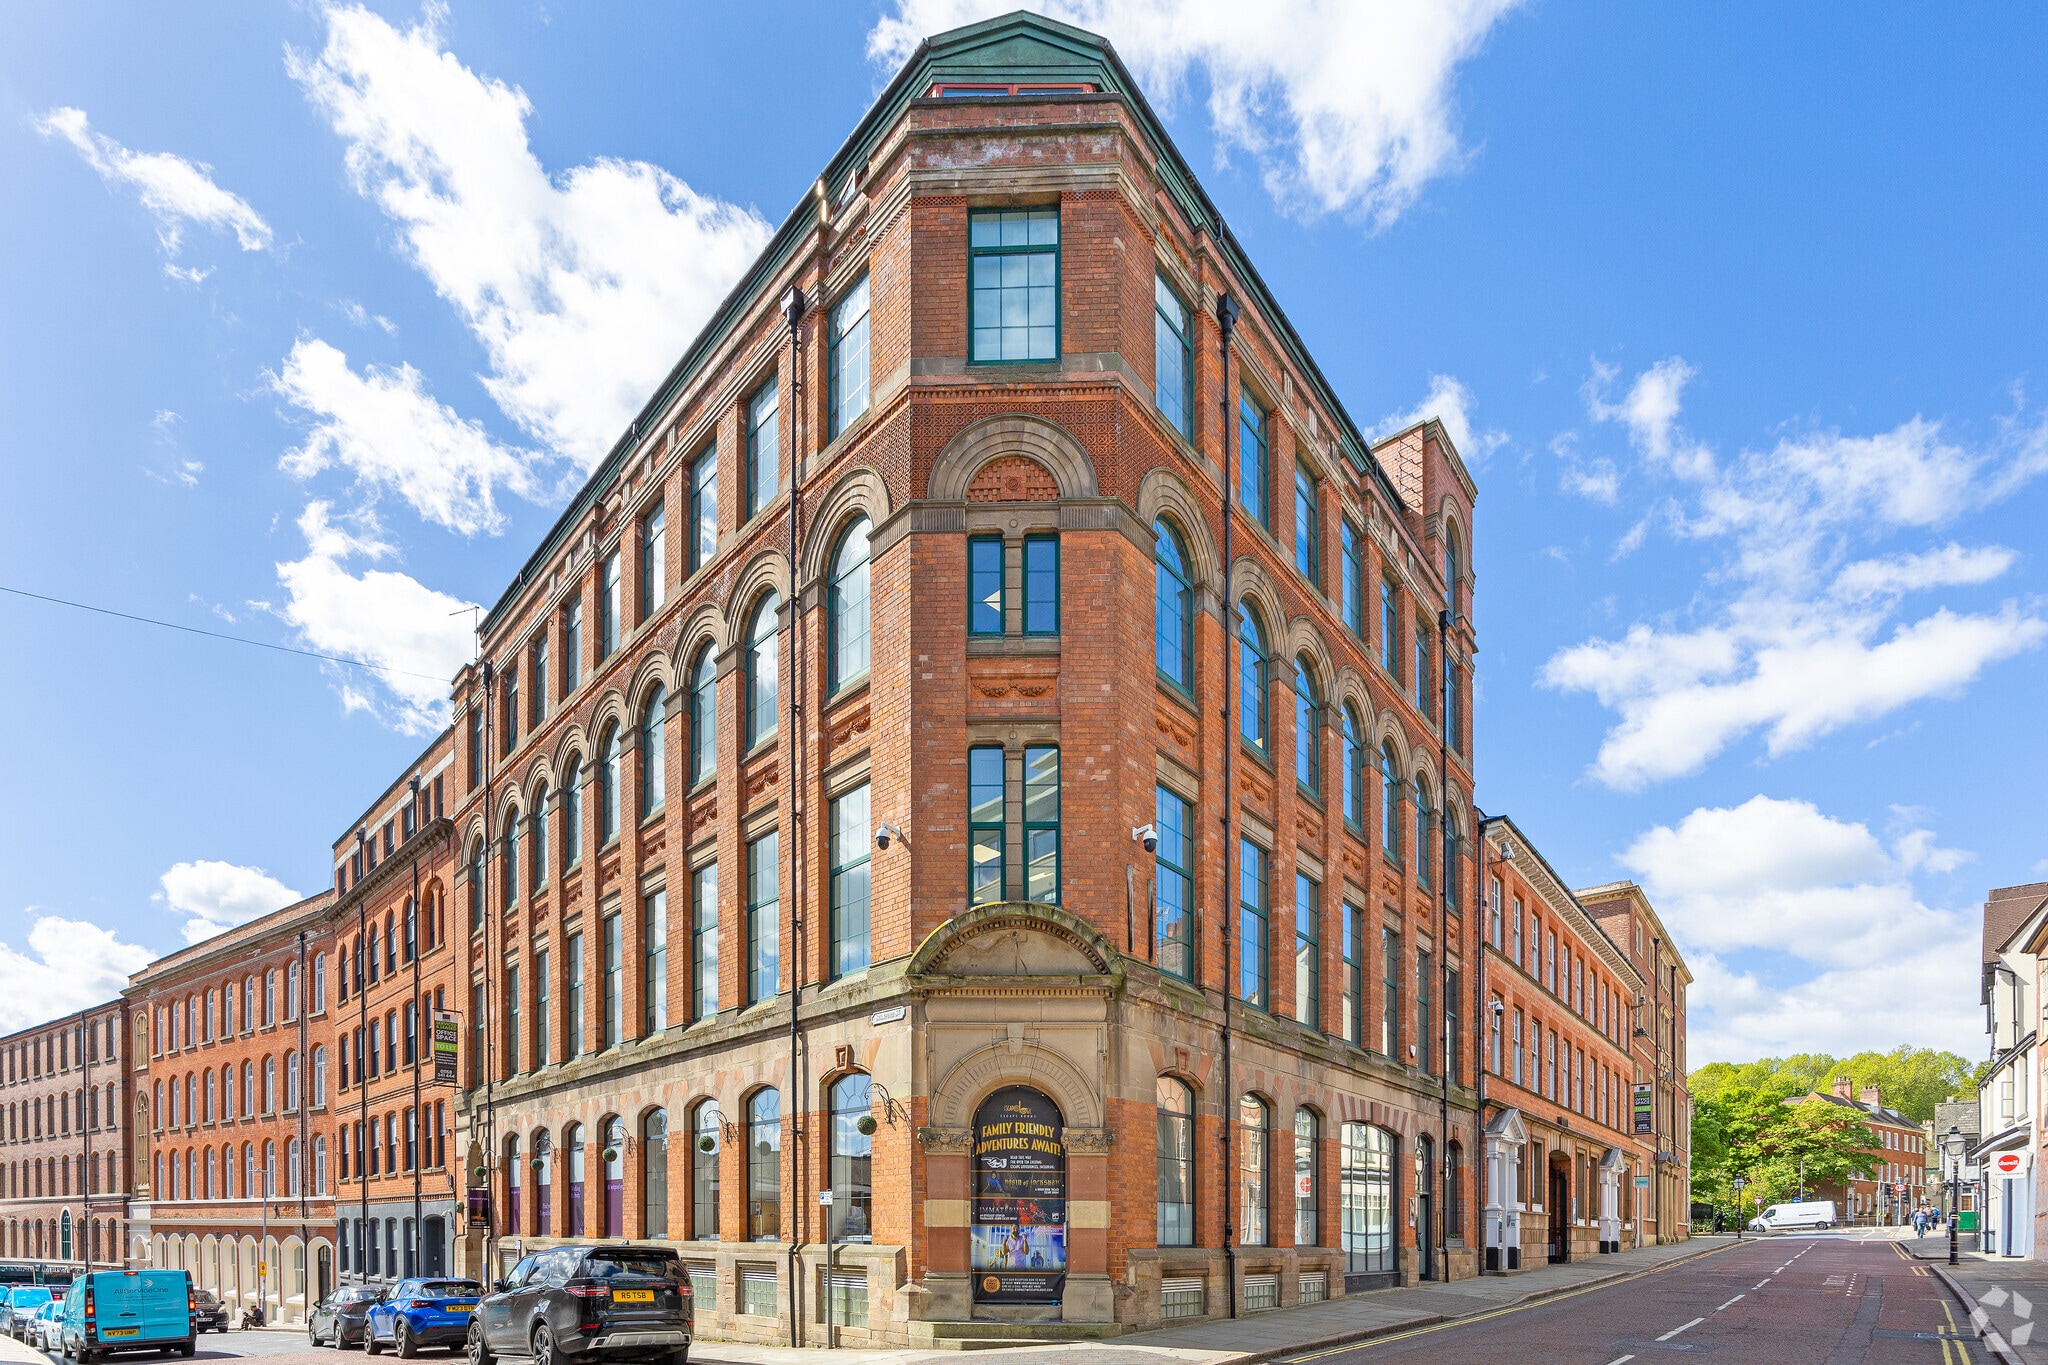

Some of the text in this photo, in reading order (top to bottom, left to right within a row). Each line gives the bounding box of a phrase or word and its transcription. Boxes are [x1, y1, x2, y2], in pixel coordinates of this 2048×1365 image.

[982, 1122, 1055, 1138] FAMILY FRIENDLY
[975, 1137, 1062, 1156] ADVENTURES AWAIT!
[114, 1287, 169, 1295] AllServiceOne
[621, 1291, 647, 1299] R5 TSB
